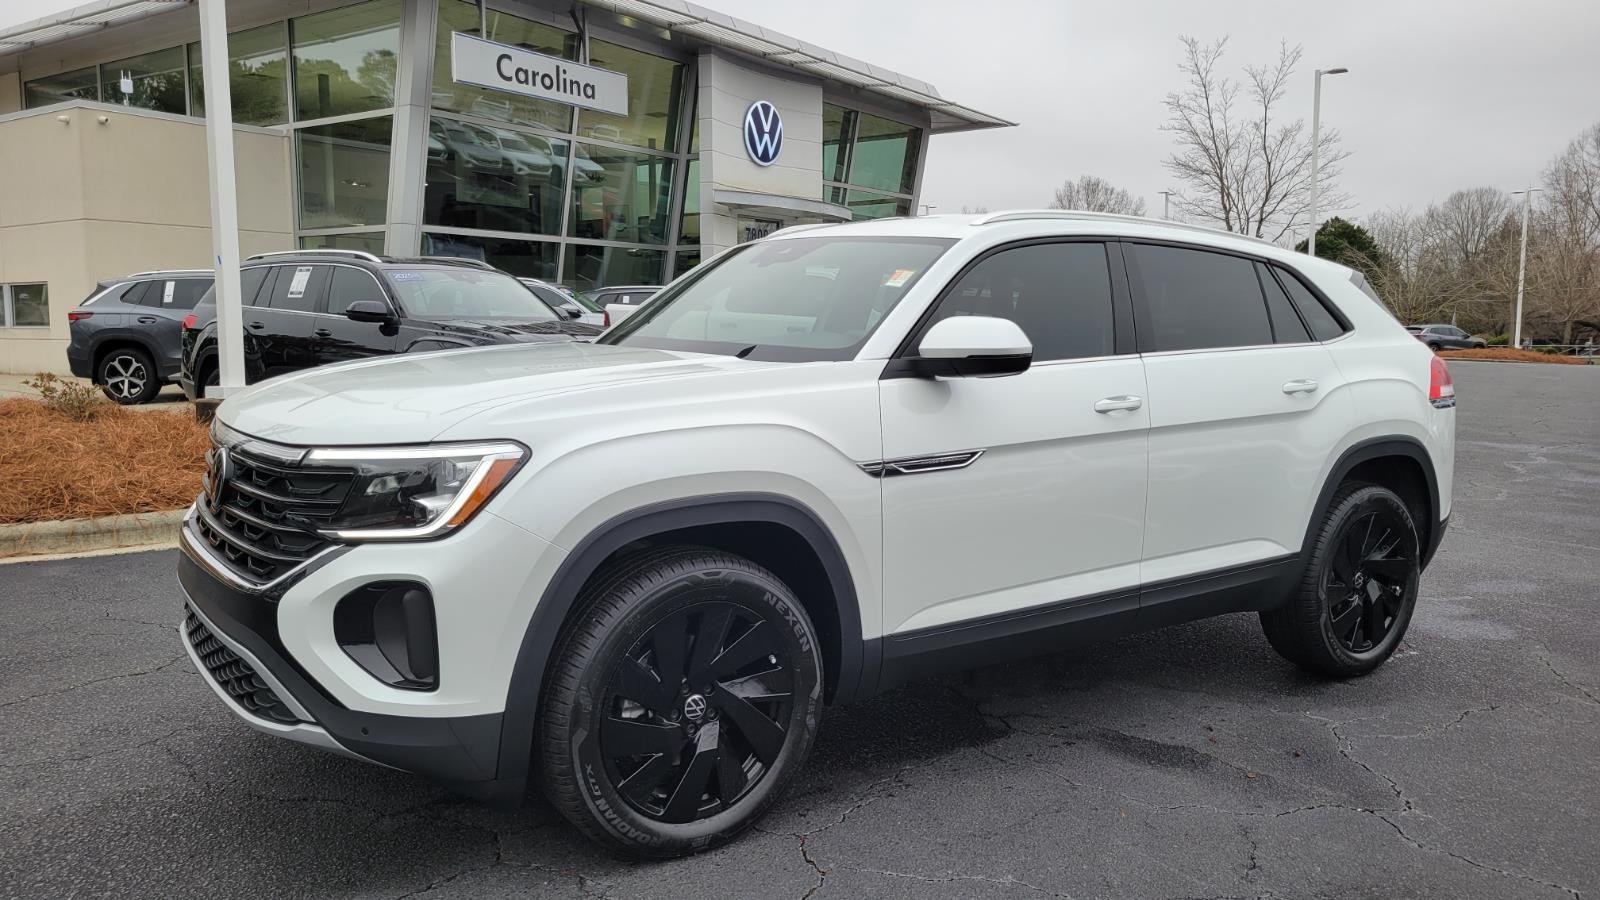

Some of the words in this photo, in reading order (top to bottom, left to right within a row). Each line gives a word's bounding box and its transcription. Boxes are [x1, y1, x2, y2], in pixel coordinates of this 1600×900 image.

[496, 53, 596, 100] Carolina
[745, 101, 783, 162] VW
[763, 591, 811, 652] NEXEN
